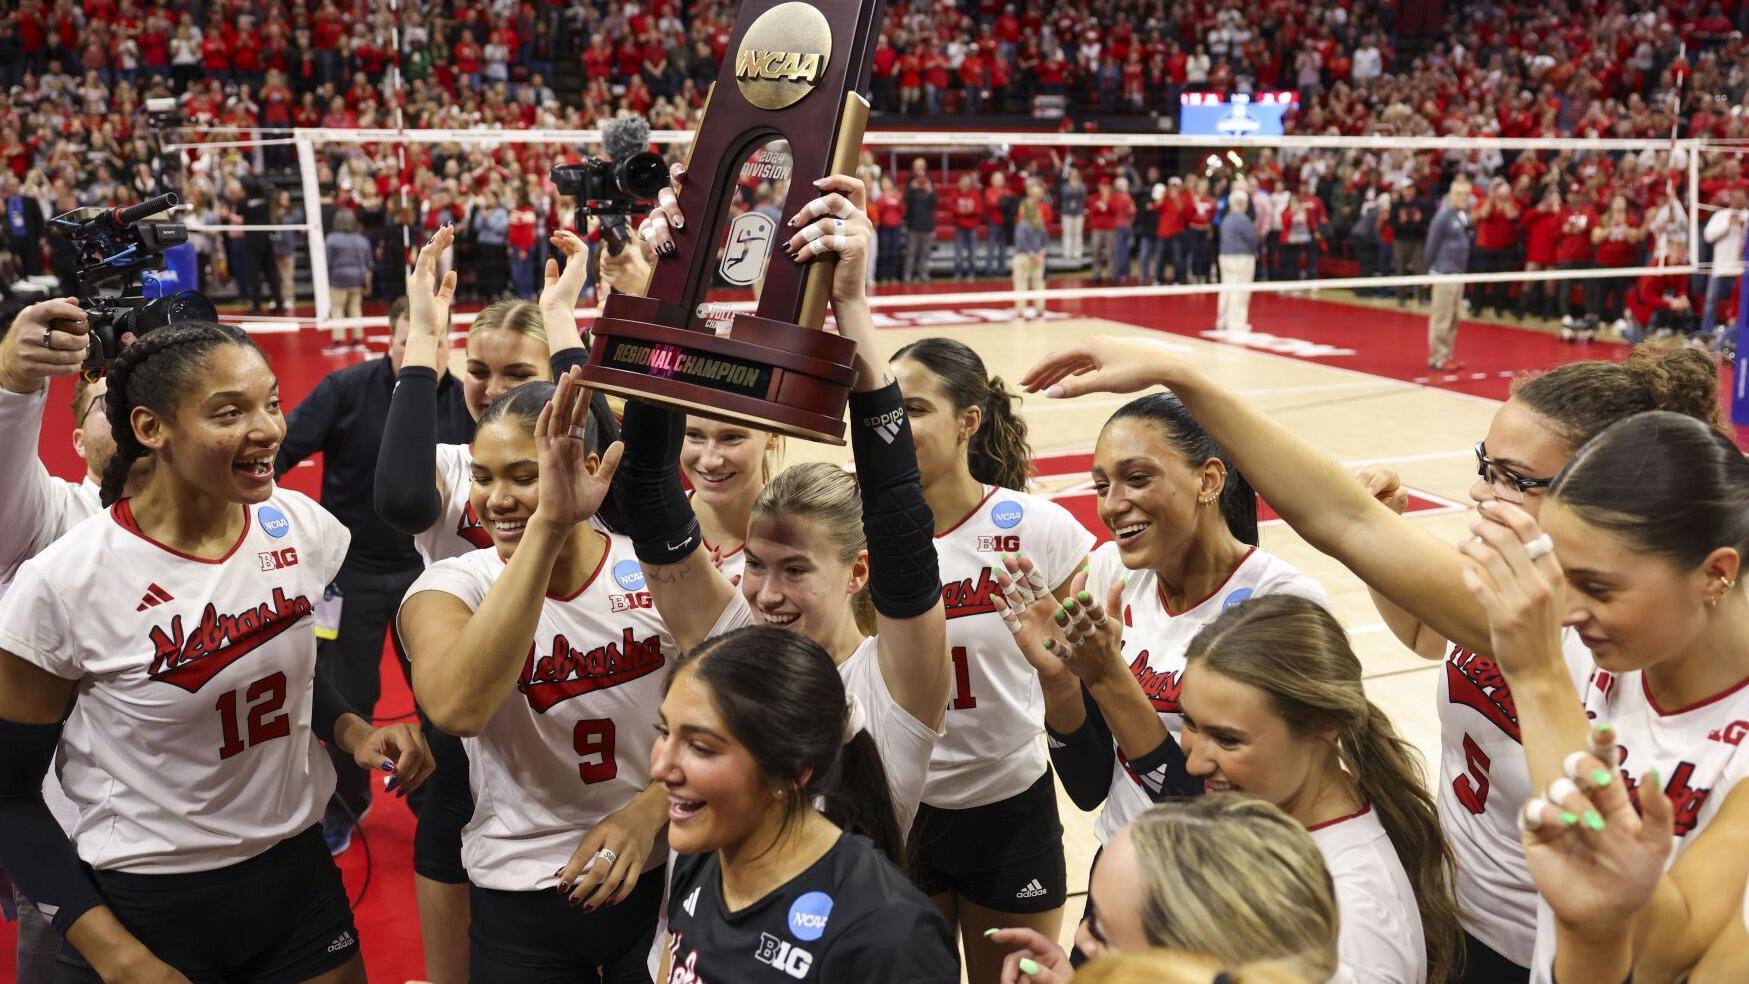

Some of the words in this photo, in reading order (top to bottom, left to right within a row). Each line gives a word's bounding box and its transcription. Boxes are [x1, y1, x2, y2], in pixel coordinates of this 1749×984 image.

[736, 50, 822, 83] NCAA
[740, 162, 791, 180] DIVISION
[759, 151, 785, 163] 2024
[614, 343, 673, 370] REGIONAL
[674, 353, 761, 388] CHAMPION
[264, 516, 289, 530] NCAA
[995, 510, 1021, 521] NCAA
[147, 587, 313, 677] Nebraska
[216, 671, 290, 760] 12
[573, 718, 618, 785] 9
[1453, 732, 1490, 815] 5
[1016, 888, 1047, 898] adidas
